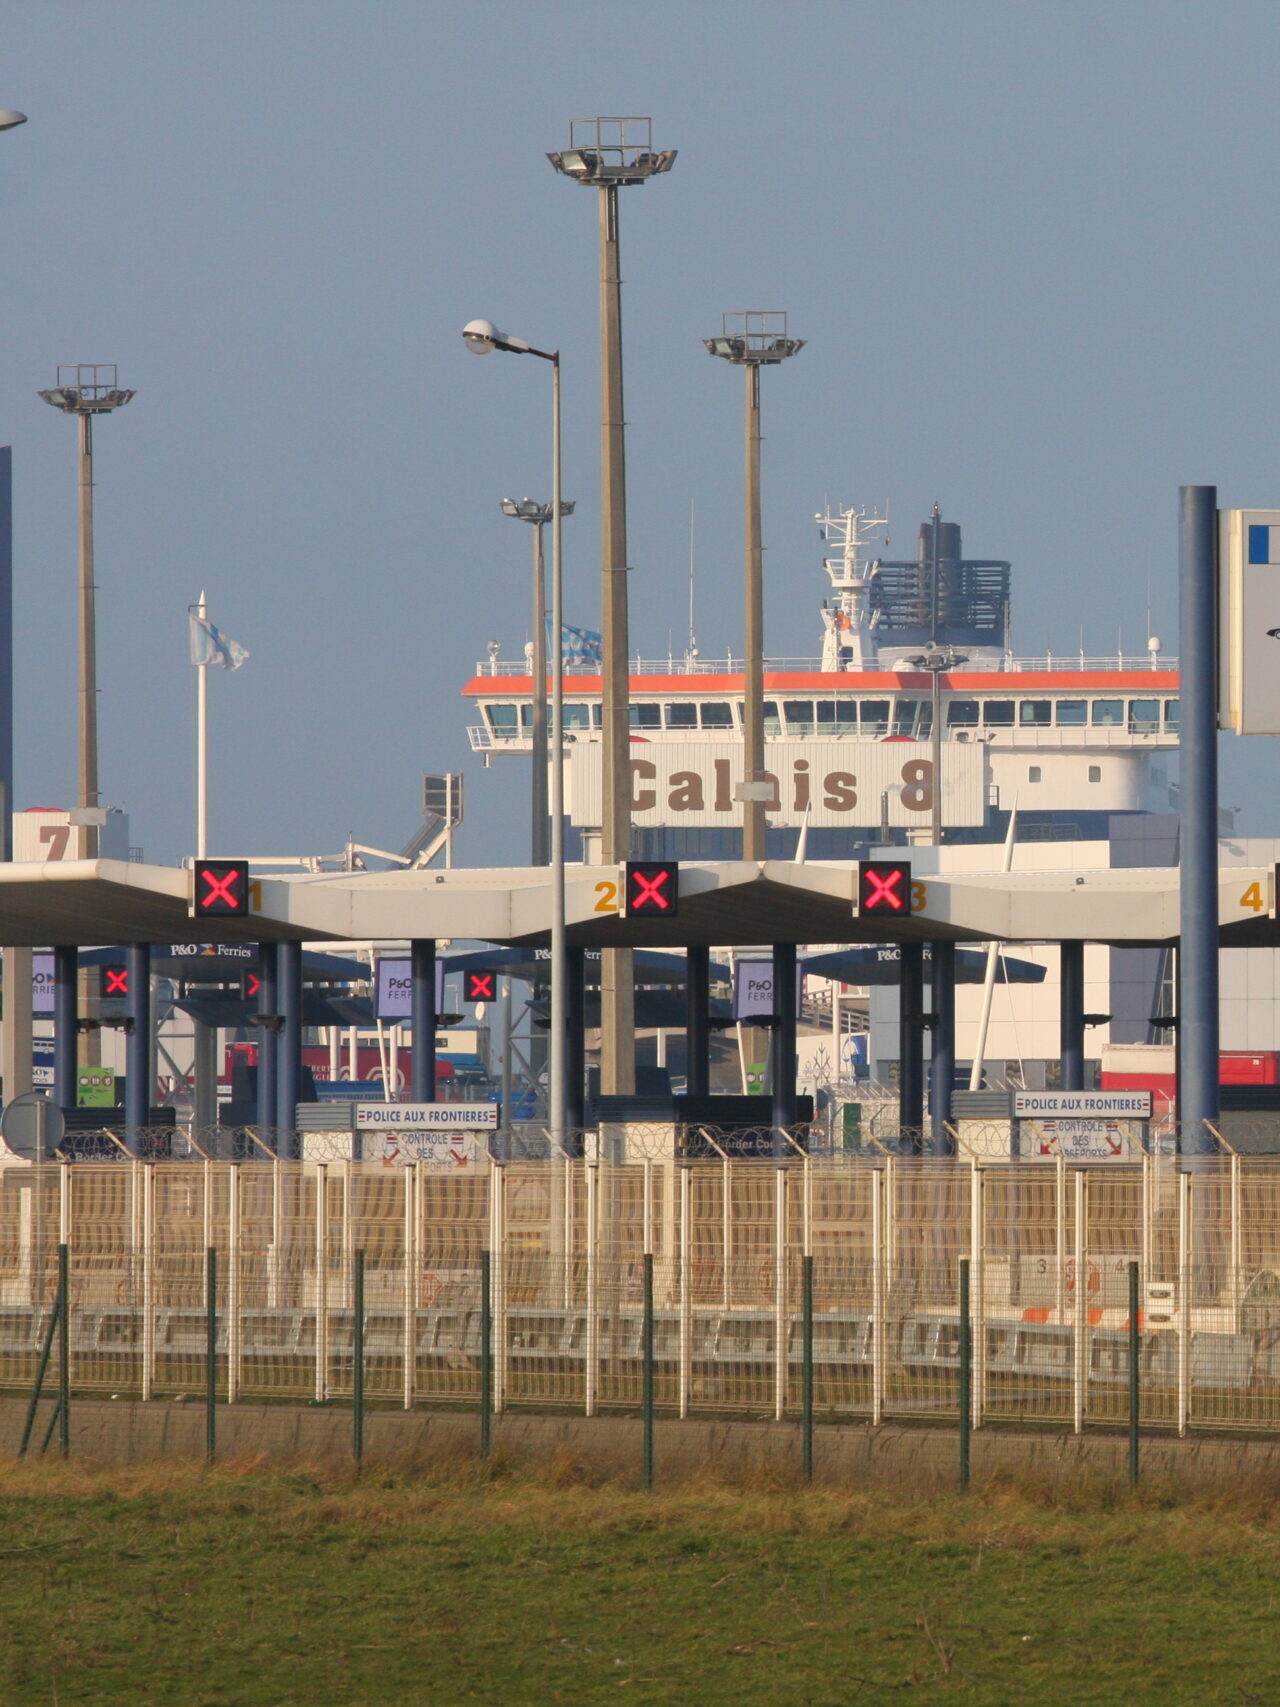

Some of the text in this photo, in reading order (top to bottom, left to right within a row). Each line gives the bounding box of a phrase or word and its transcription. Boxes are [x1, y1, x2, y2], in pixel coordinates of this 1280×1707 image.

[900, 759, 934, 812] 8
[40, 826, 70, 861] 7
[594, 881, 617, 912] 2
[911, 882, 927, 912] 3
[1240, 882, 1263, 912] 4
[171, 944, 252, 957] P&O Ferries
[534, 948, 552, 960] P&
[748, 992, 773, 1000] FERR
[1025, 1099, 1142, 1110] POLICE AUX FRONTIERES
[367, 1111, 489, 1122] POLICE AUX FRONTIERES
[1058, 1121, 1103, 1132] CONTROLE
[1072, 1136, 1089, 1146] DES
[1037, 1259, 1047, 1274] 3
